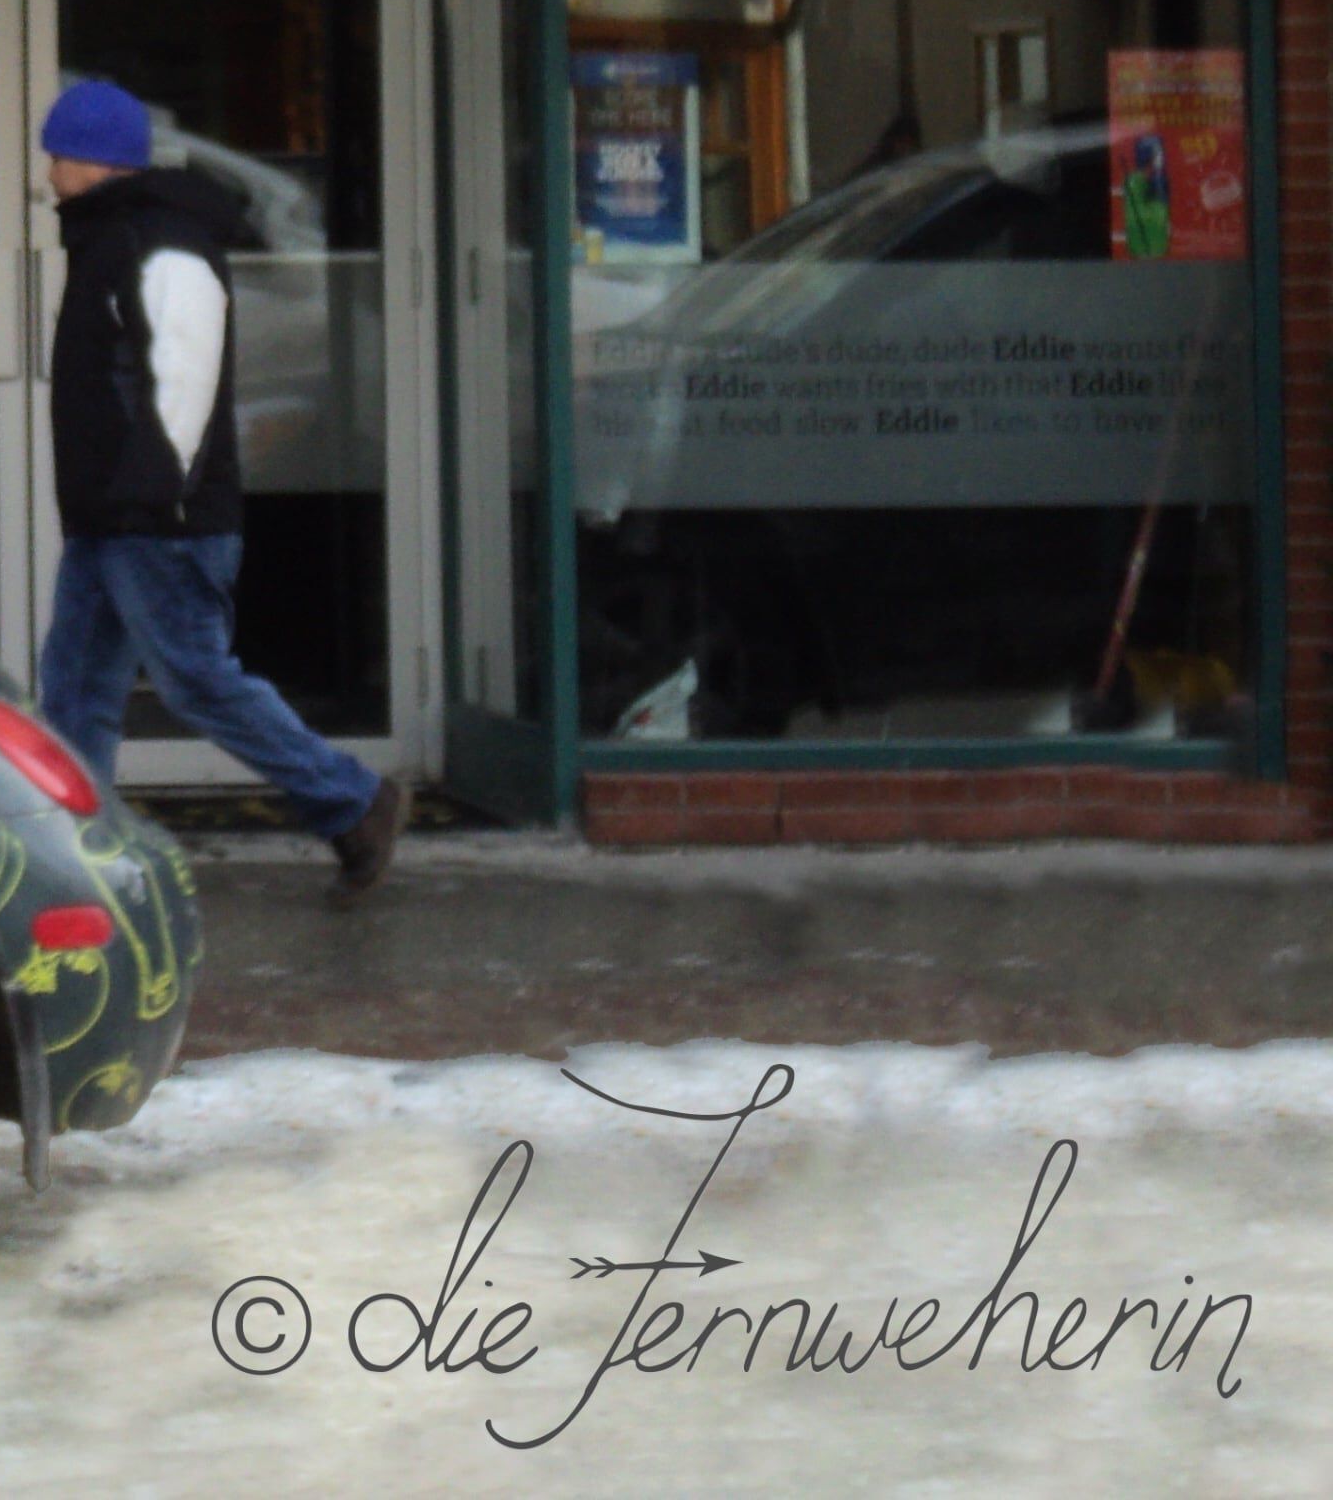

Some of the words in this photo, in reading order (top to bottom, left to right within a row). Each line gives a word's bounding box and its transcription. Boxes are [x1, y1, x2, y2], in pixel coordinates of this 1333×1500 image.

[992, 334, 1076, 362] Eddie
[684, 373, 766, 399] Eddie
[1069, 370, 1153, 397] Eddie
[874, 407, 960, 434] Eddie
